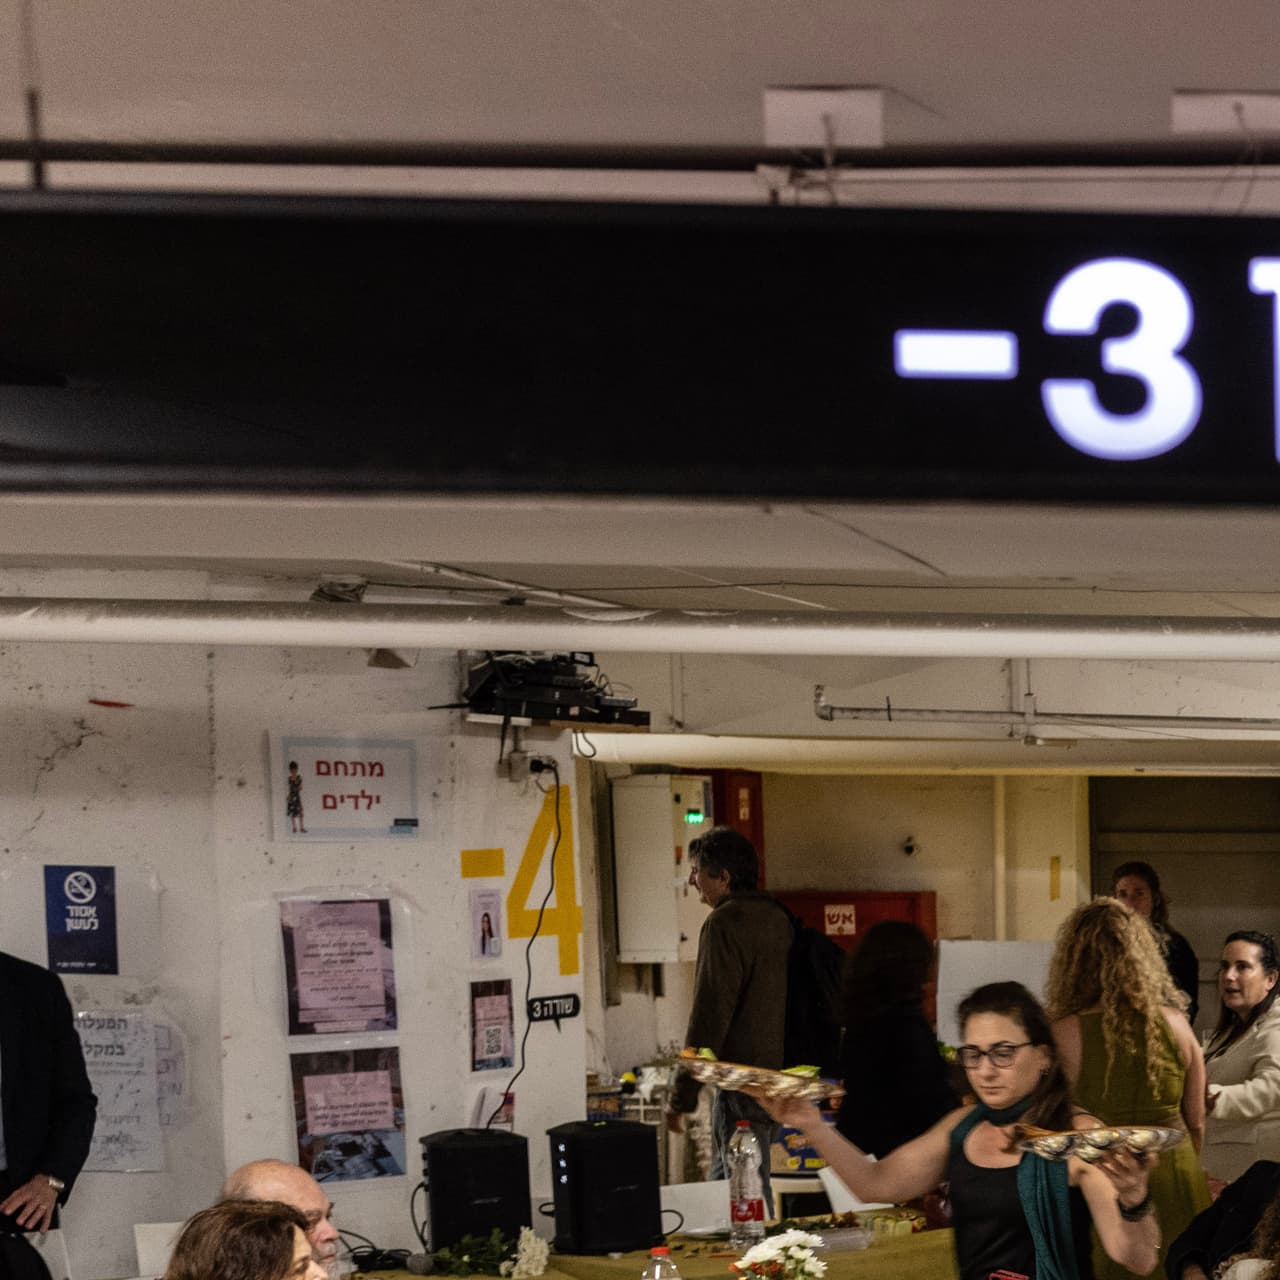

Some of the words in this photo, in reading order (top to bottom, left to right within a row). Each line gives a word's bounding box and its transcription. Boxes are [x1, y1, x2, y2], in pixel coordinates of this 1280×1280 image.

[893, 256, 1202, 461] -3
[315, 759, 385, 777] מתחם
[321, 789, 382, 811] ילדים
[460, 784, 583, 976] -4
[65, 904, 97, 919] אסור
[826, 912, 854, 925] אש
[64, 917, 99, 932] לעשן
[532, 998, 542, 1018] 3
[542, 994, 575, 1018] שורה
[84, 1040, 126, 1058] במקל
